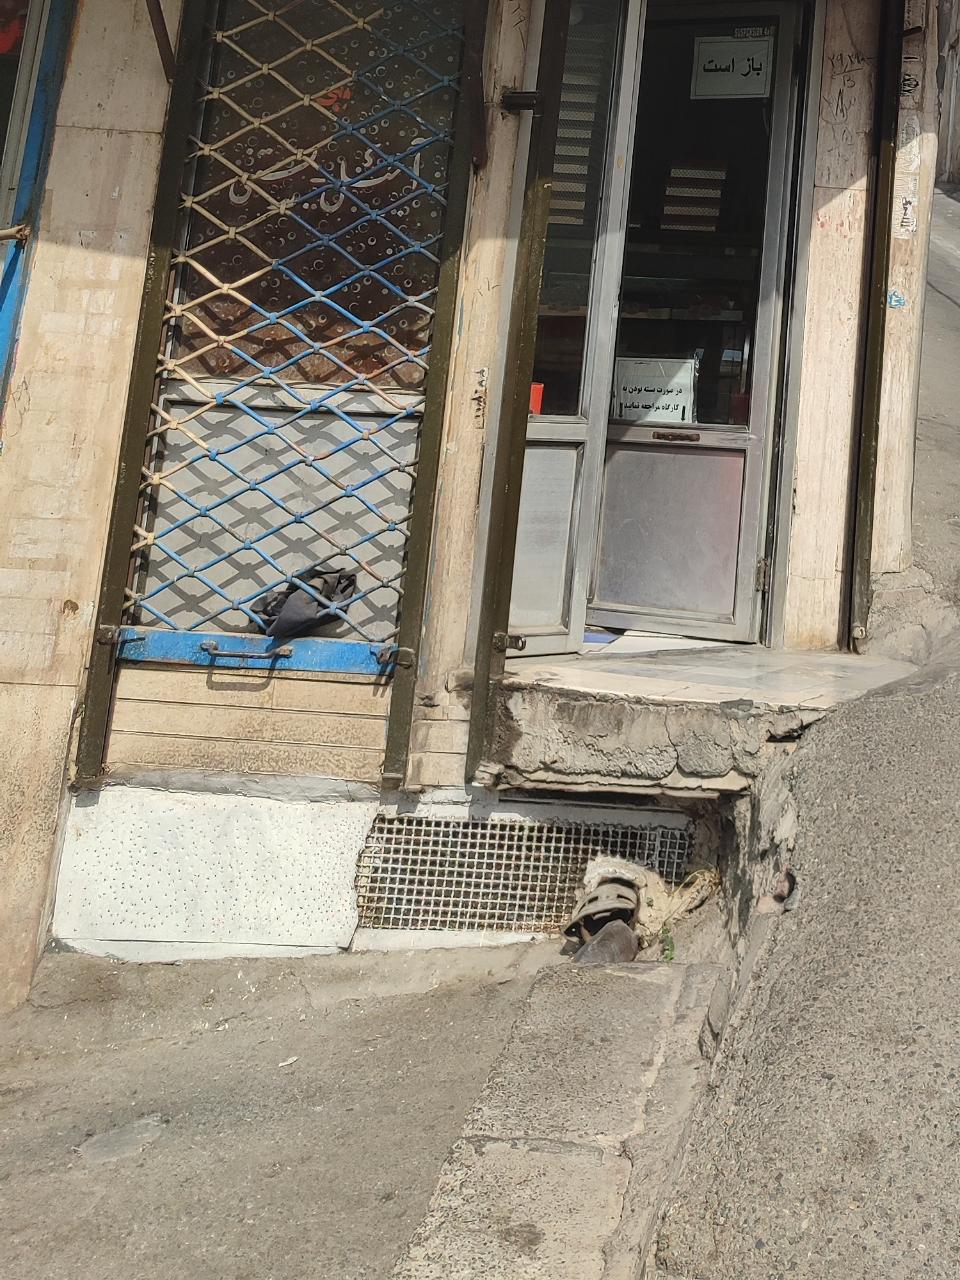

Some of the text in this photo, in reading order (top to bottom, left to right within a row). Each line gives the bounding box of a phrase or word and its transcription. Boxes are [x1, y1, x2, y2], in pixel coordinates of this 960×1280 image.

[703, 56, 763, 77] باز است
[656, 386, 674, 396] صورت
[675, 387, 683, 396] در
